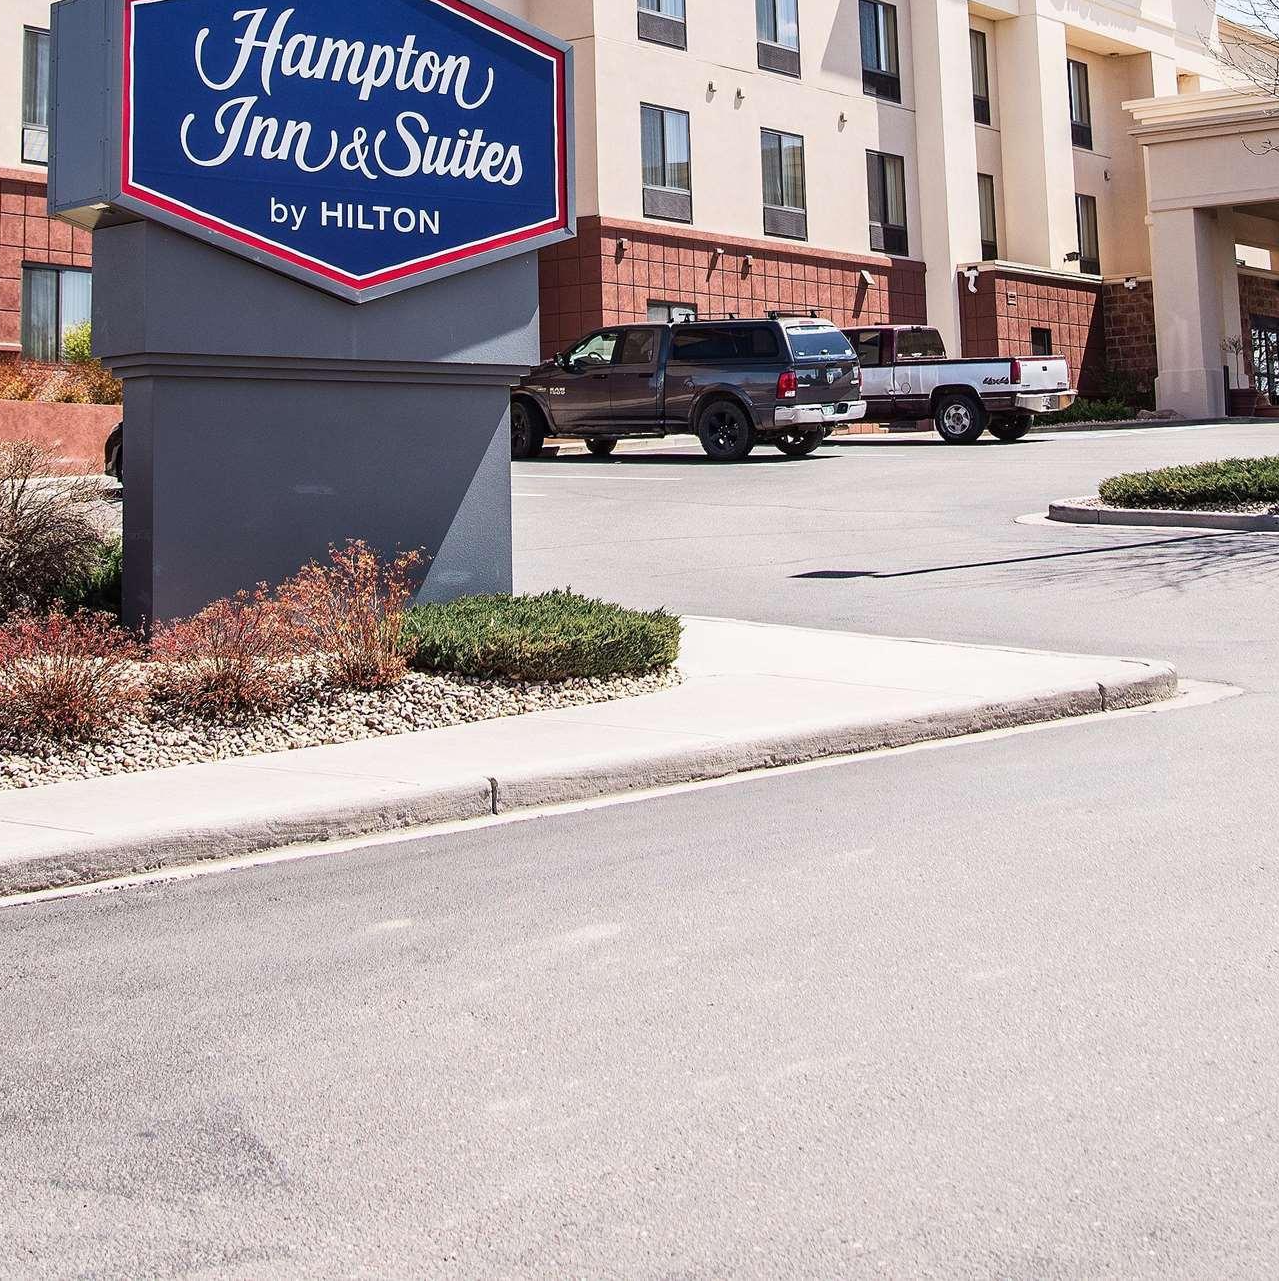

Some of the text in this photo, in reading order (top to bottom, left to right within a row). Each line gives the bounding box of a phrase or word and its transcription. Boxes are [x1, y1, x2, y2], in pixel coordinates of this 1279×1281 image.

[194, 7, 494, 111] Hampton
[180, 95, 523, 187] Inn & Suites
[269, 197, 440, 235] by HILTON
[982, 376, 1010, 386] 4x4
